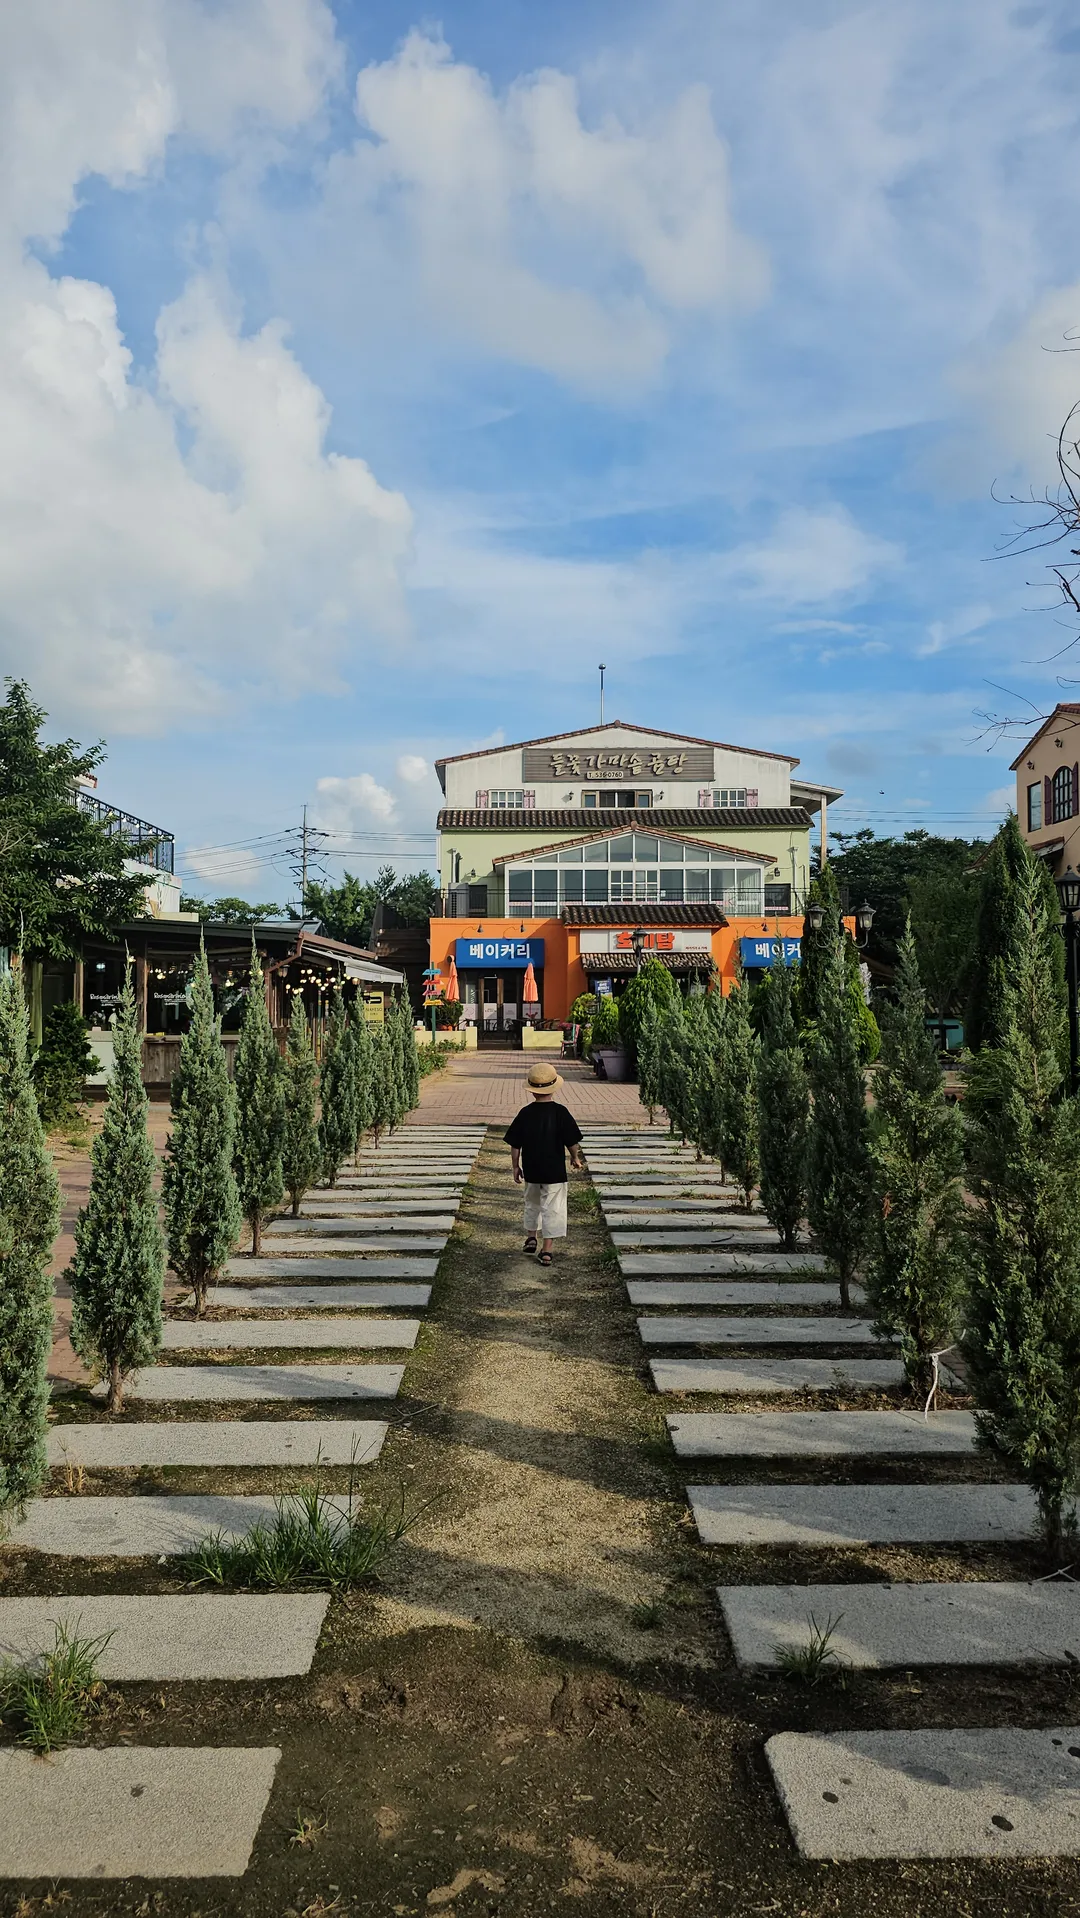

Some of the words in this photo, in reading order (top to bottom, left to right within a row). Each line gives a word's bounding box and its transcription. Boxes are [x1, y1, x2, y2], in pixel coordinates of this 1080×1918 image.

[550, 752, 581, 776] 들꽃
[469, 943, 530, 959] 베이커리
[755, 943, 802, 959] 베이커
